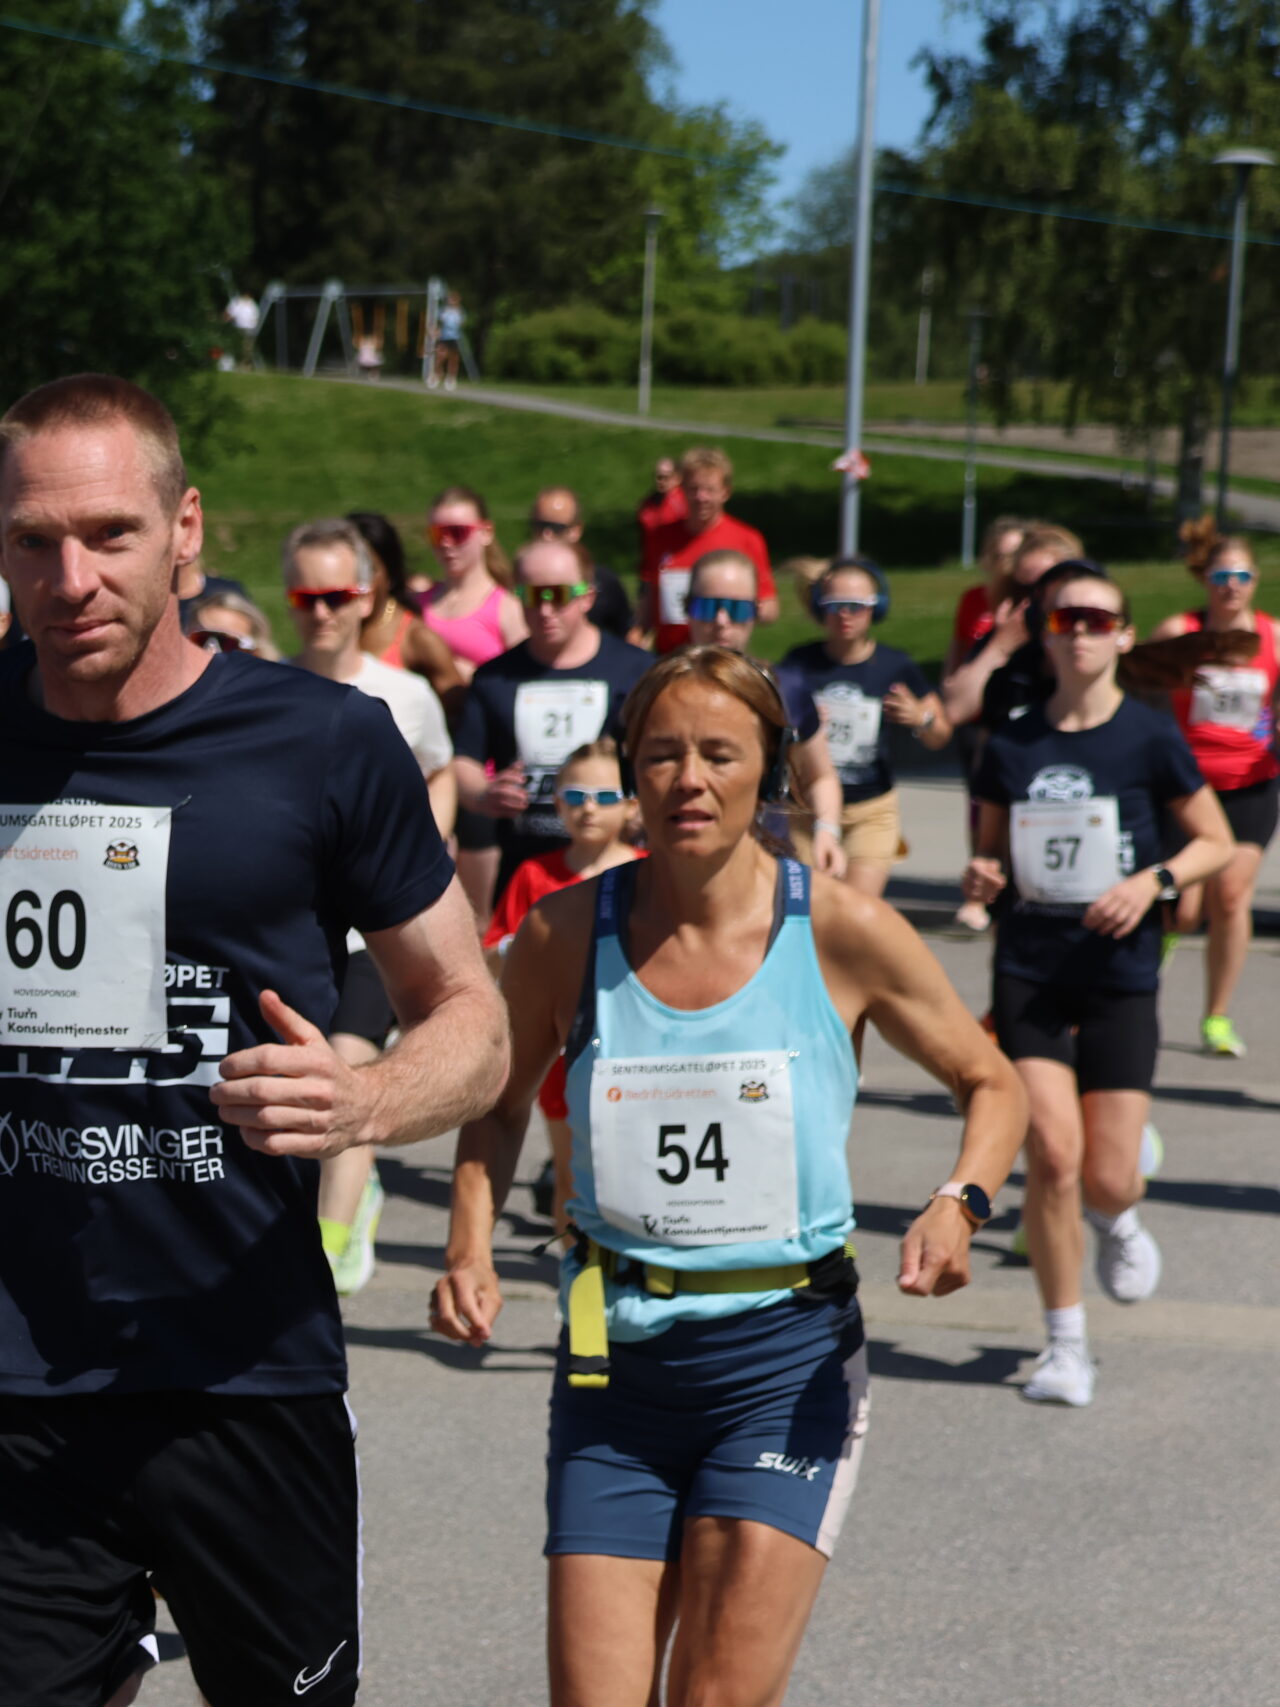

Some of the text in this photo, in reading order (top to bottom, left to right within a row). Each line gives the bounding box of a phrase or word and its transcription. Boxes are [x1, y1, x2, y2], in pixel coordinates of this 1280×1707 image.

[543, 711, 574, 738] 21
[108, 815, 143, 829] 2025
[1044, 835, 1083, 872] 57
[5, 889, 87, 971] 60
[7, 1021, 130, 1038] Konsulenttjenester
[611, 1061, 736, 1076] SENTRUMSGATELØPET
[20, 1120, 224, 1160] KONGSVINGER
[656, 1122, 729, 1185] 54
[25, 1153, 225, 1185] TRENINGSSENTER
